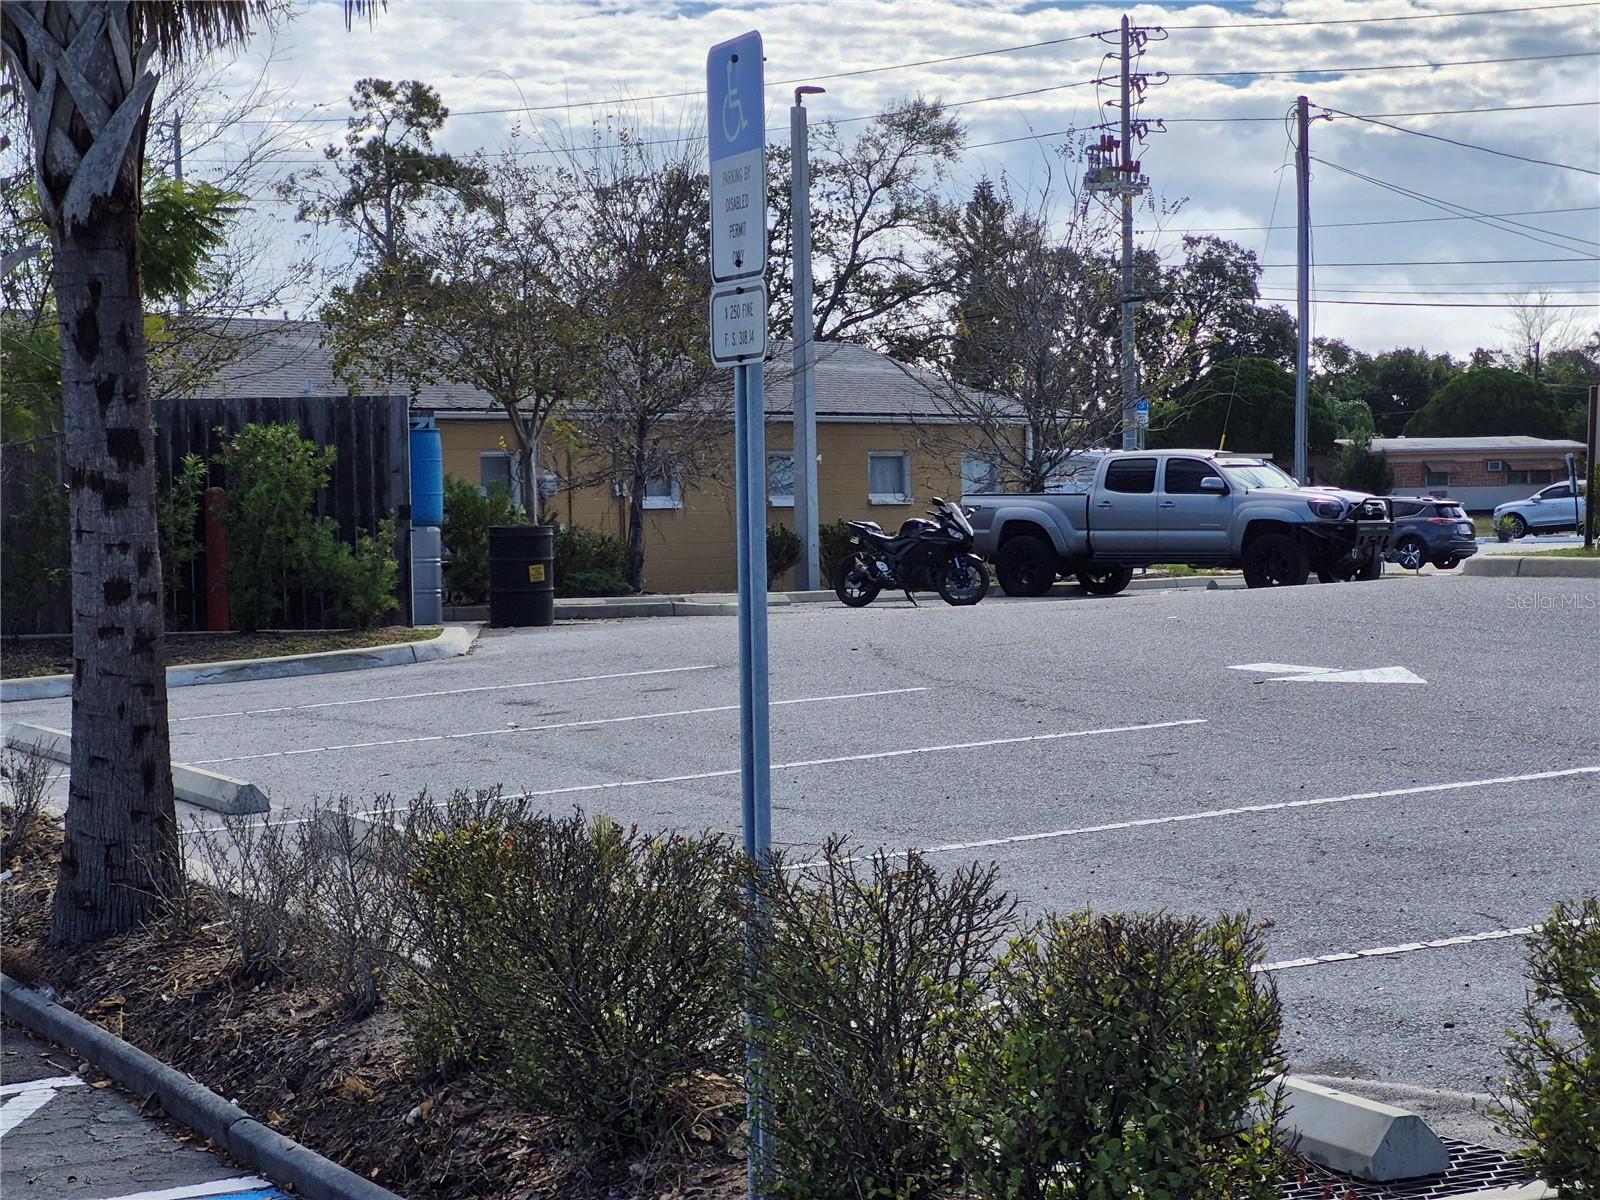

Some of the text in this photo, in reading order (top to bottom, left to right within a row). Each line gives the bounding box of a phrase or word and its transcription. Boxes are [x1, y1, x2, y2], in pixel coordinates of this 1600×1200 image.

[722, 165, 751, 186] PARKING BY
[725, 193, 749, 212] DISABLED
[729, 221, 746, 239] PERMIT
[730, 304, 741, 320] 250
[742, 302, 754, 318] FINE
